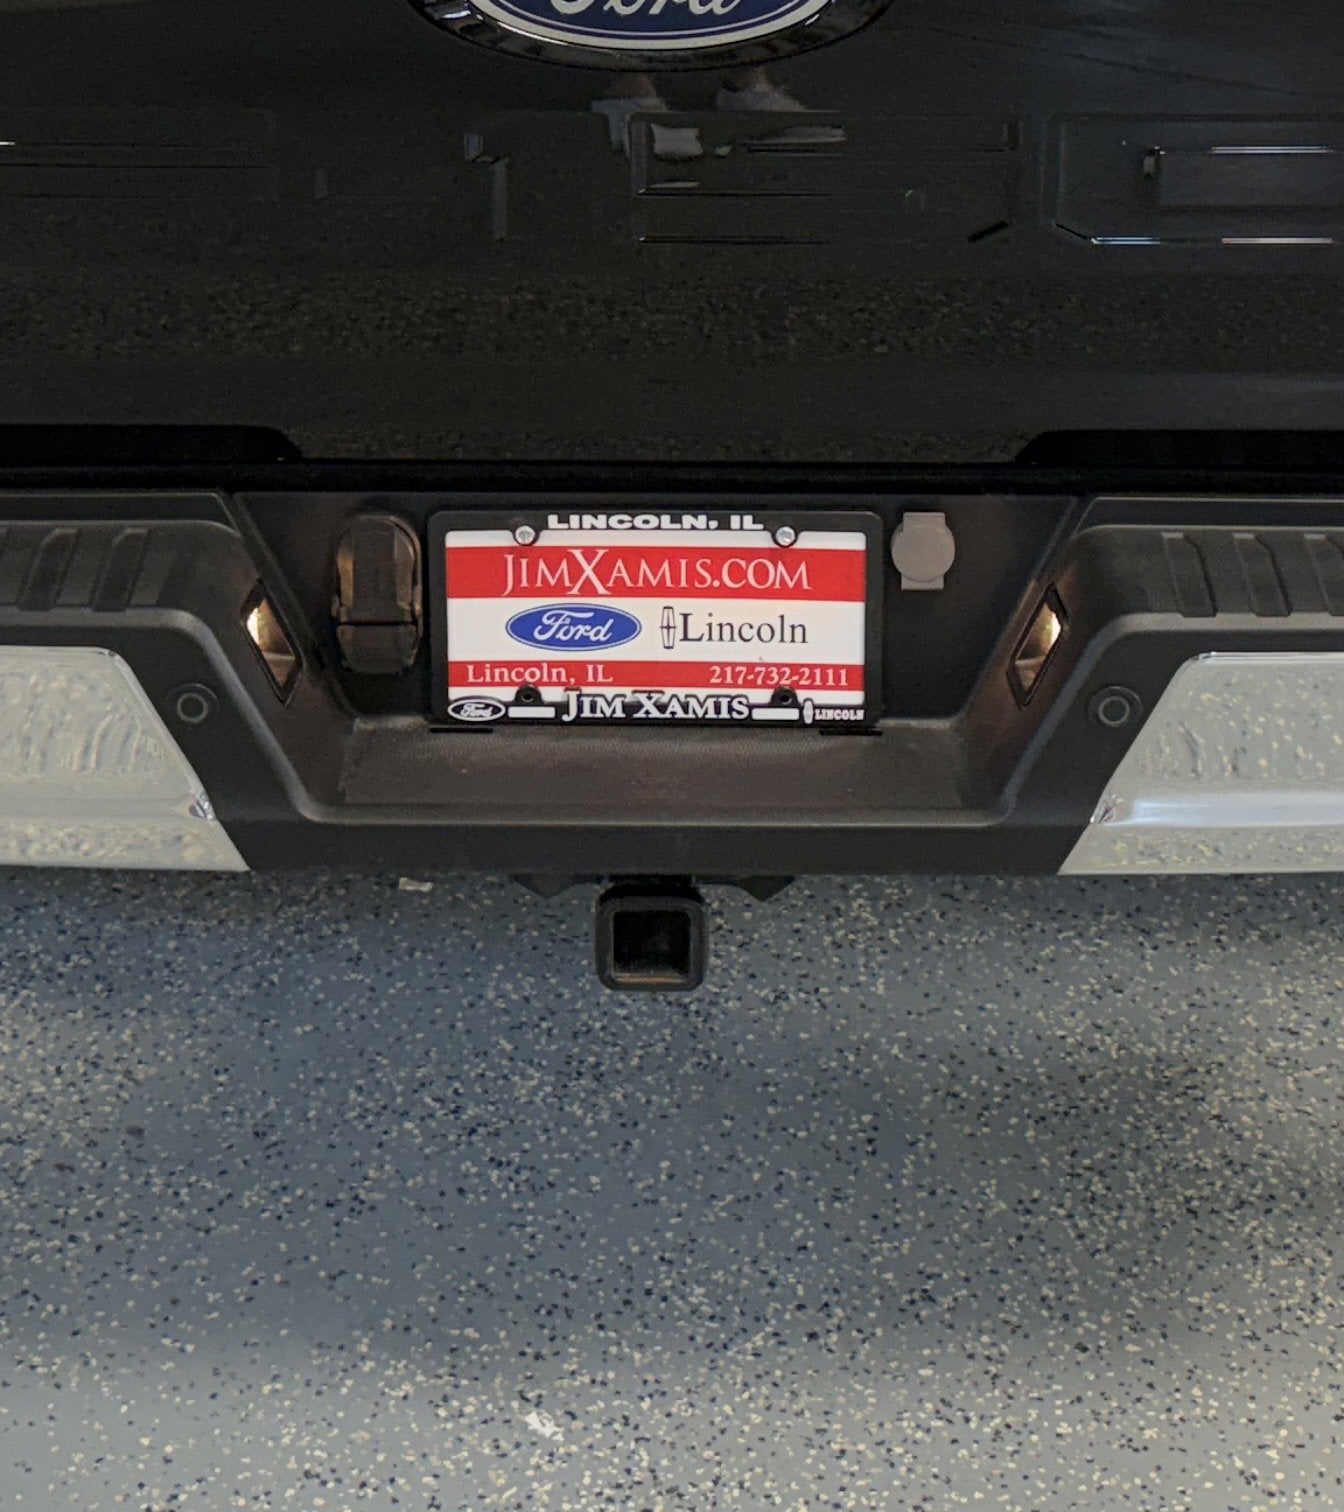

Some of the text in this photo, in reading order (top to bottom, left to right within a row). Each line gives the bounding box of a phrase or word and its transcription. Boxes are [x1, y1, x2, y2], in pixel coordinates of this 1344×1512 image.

[548, 514, 764, 530] LINCOLN, IL
[532, 608, 614, 643] Ford
[679, 613, 809, 644] Lincoln
[467, 663, 614, 685] Lincoln, IL
[709, 665, 849, 687] 217-732-2111
[459, 702, 494, 719] Ford
[561, 691, 750, 722] JIM XAMIS
[814, 708, 865, 721] LINCOLN
